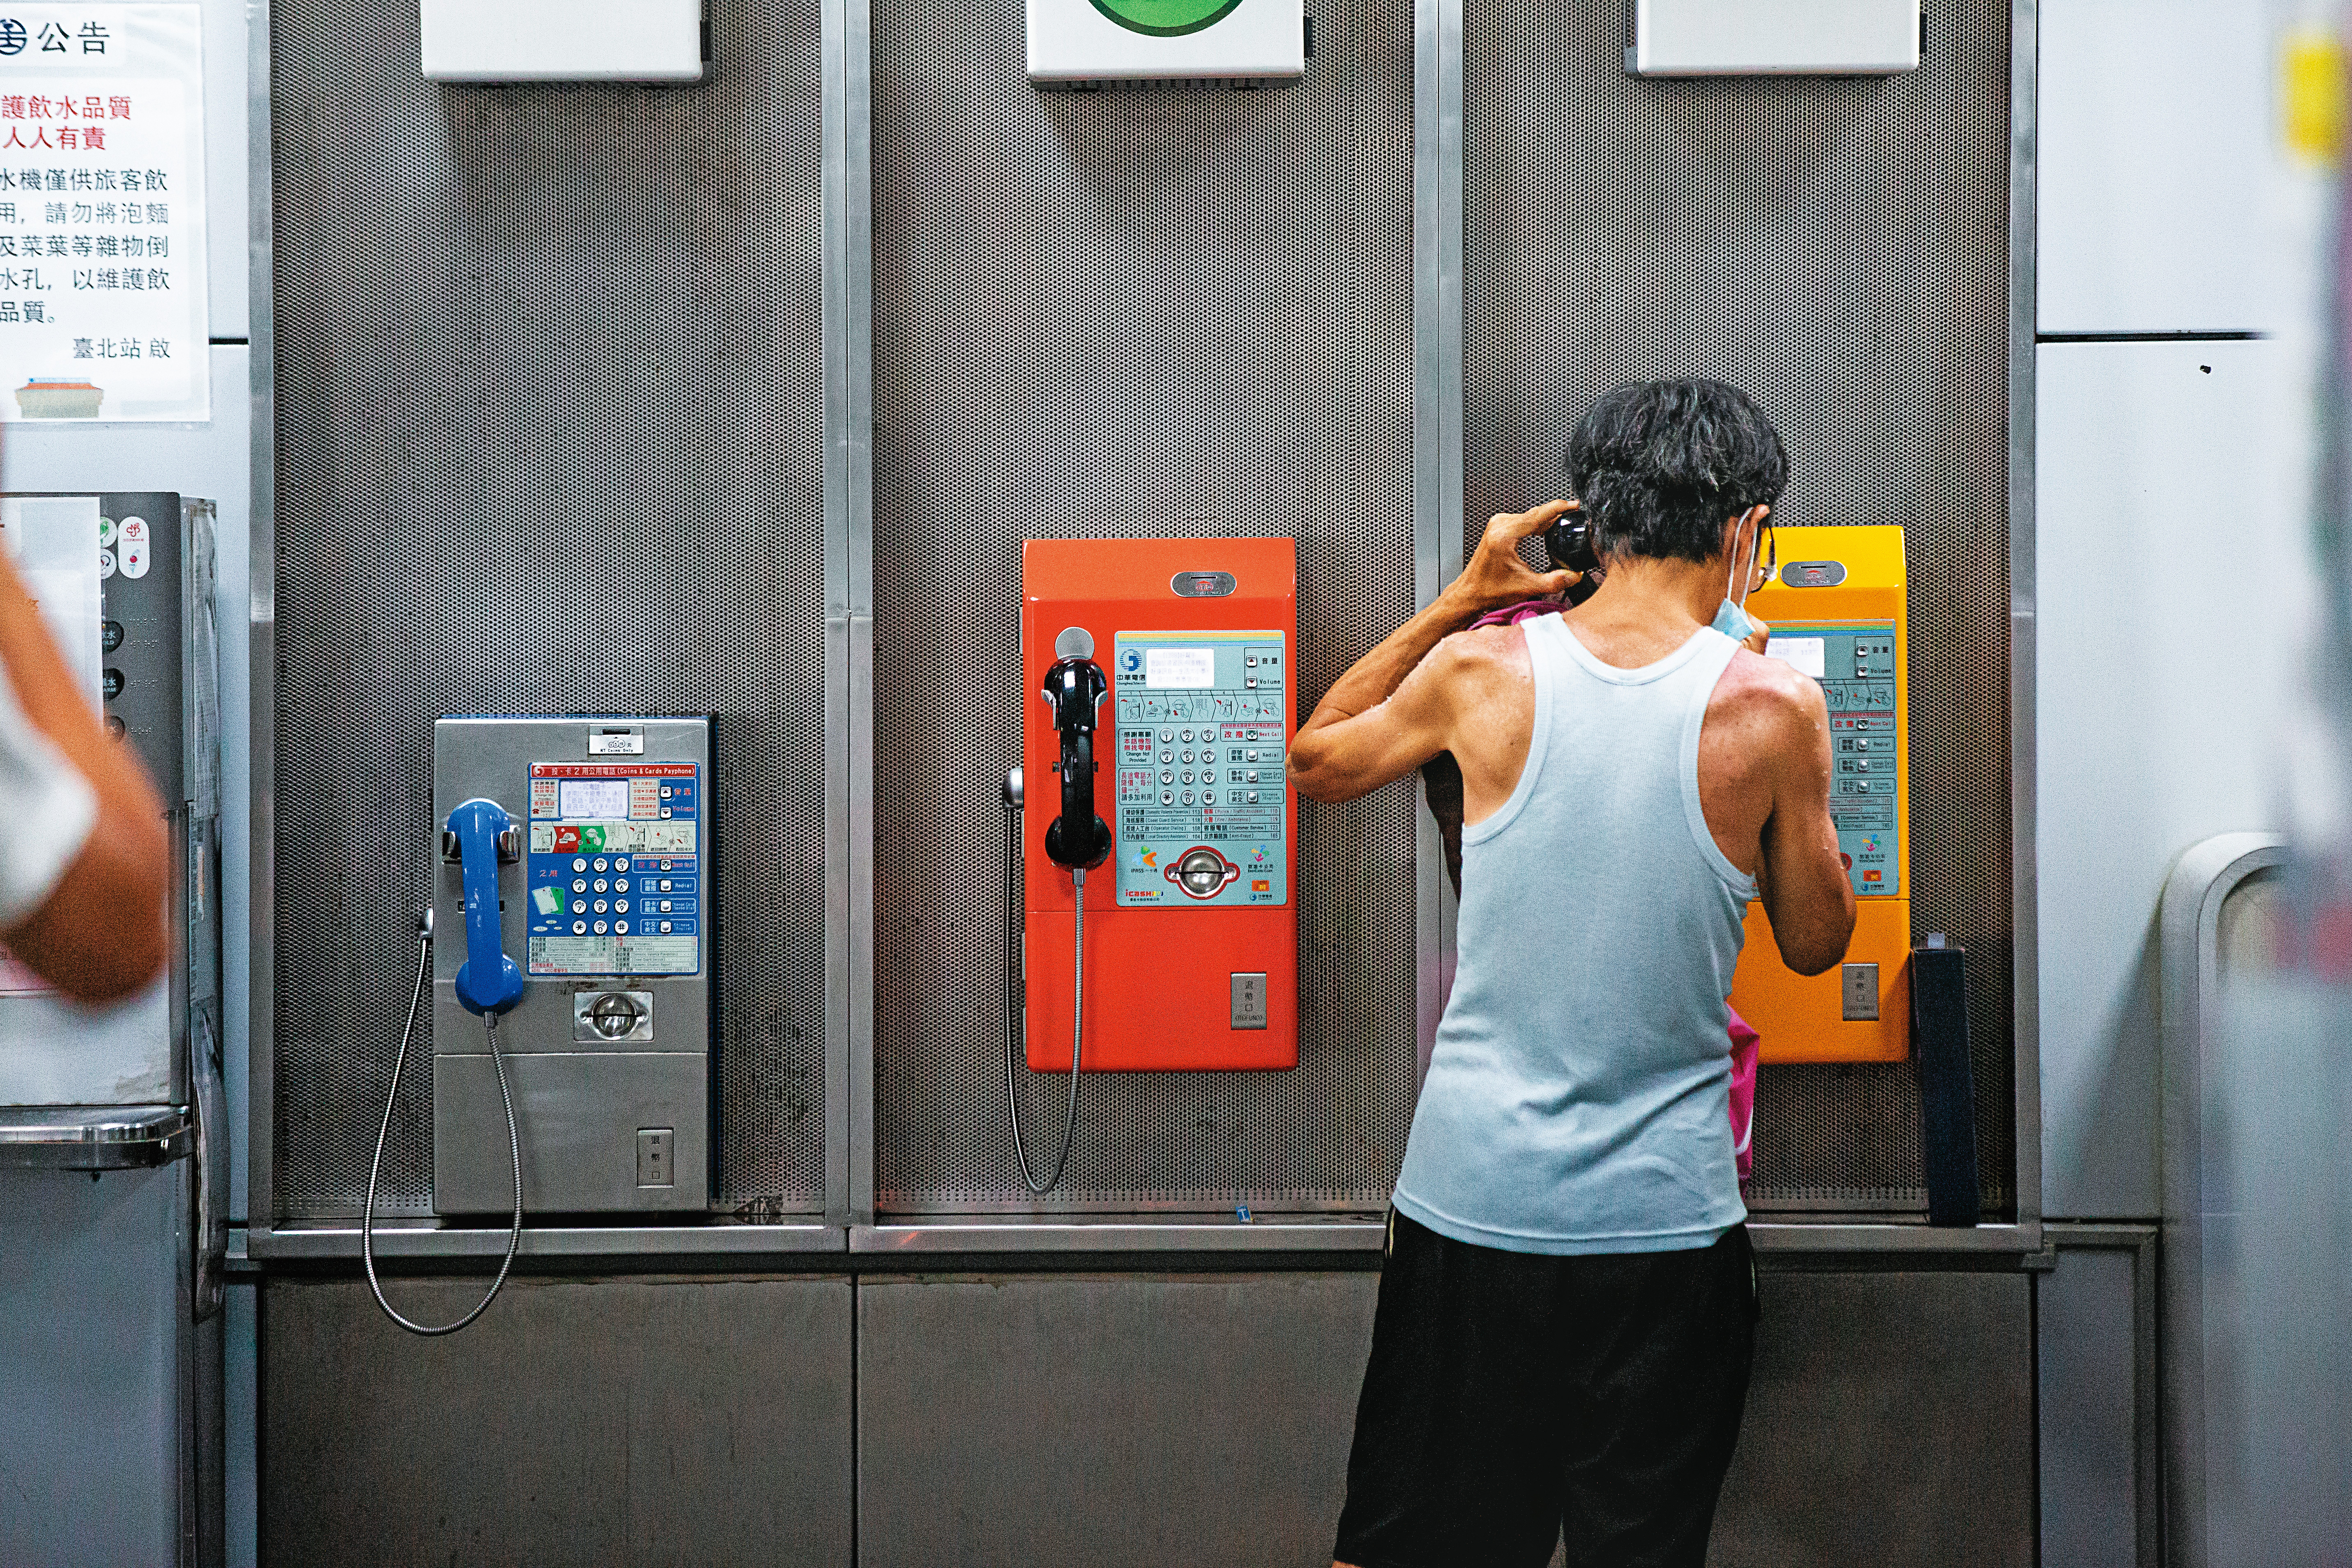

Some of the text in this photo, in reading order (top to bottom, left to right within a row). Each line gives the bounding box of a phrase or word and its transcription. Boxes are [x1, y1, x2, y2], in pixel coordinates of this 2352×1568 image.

[37, 22, 110, 55] 公告
[3, 126, 107, 151] 人人有責
